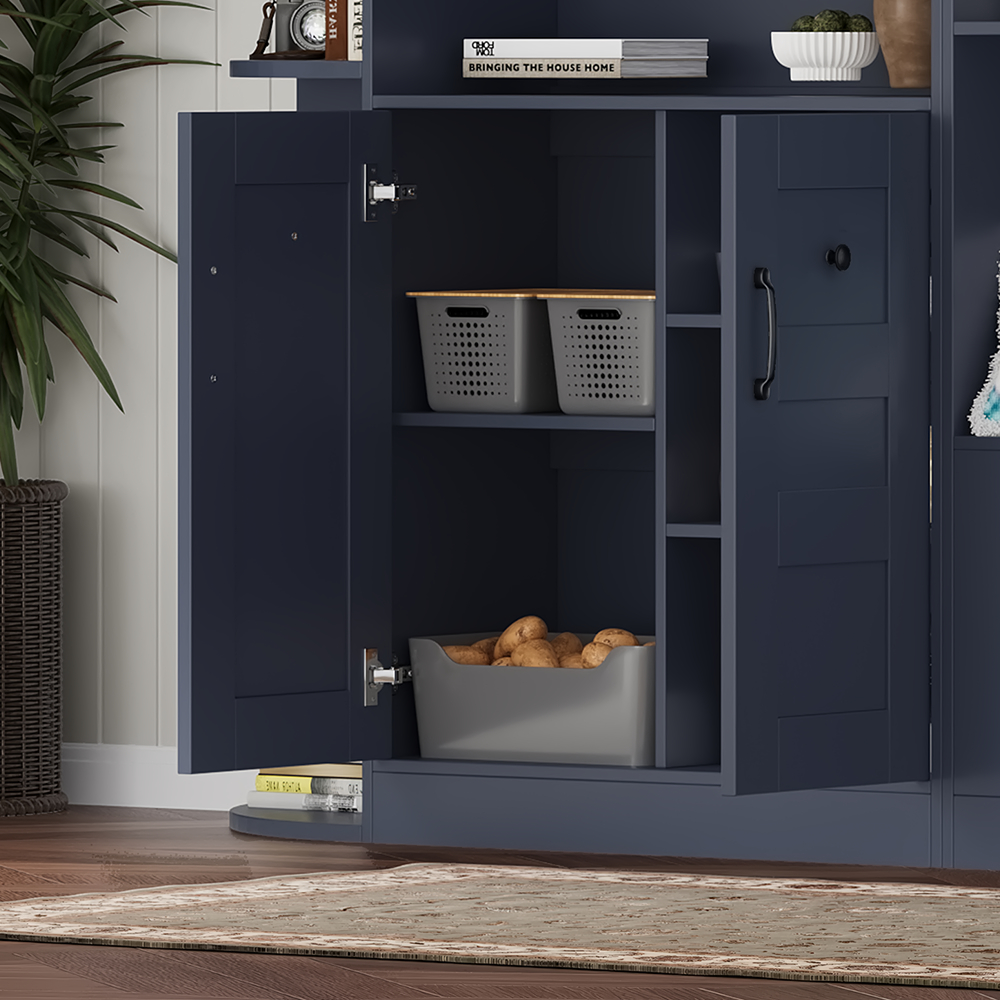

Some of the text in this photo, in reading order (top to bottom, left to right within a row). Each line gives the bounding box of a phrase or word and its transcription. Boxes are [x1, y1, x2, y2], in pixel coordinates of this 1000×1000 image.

[469, 63, 615, 72] BRINGING THE HOUSE HOME
